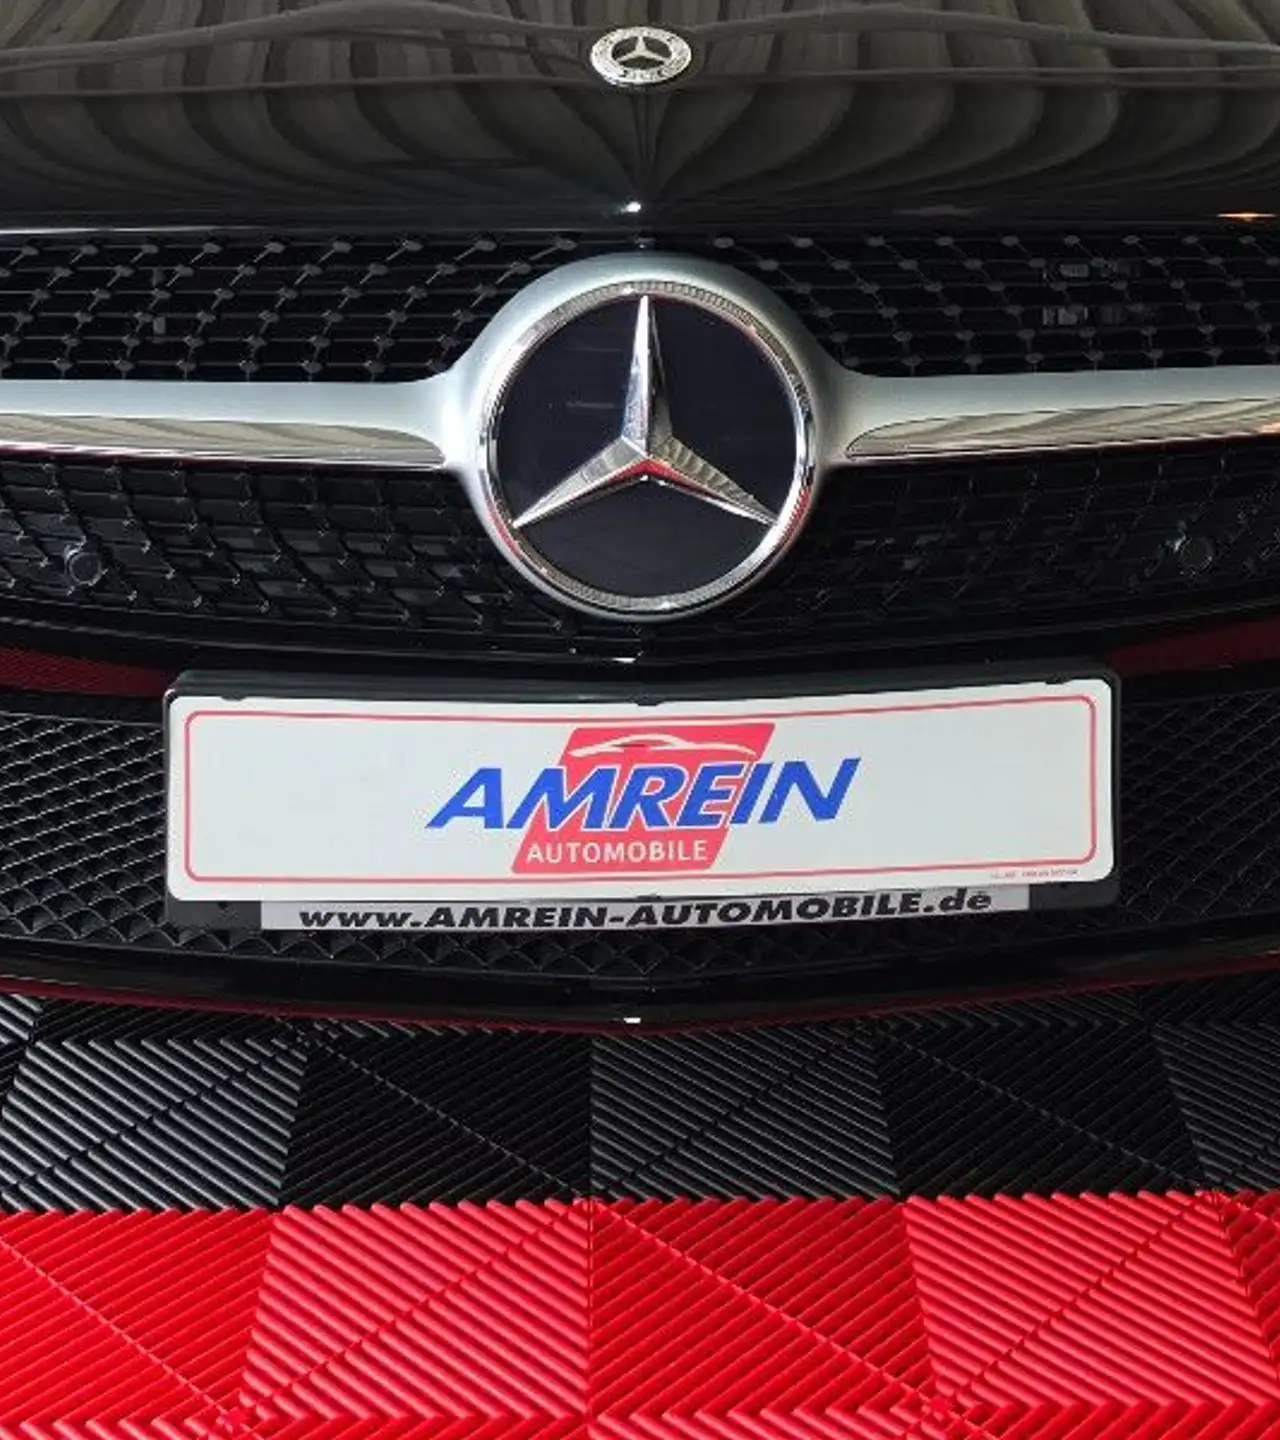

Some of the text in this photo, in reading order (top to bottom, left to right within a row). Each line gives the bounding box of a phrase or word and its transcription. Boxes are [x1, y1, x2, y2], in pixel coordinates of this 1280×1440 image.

[425, 755, 861, 833] AMREIN
[526, 838, 710, 865] AUTOMOBILE
[298, 887, 992, 930] www.AMREIN-AUTOMOBILE.de
